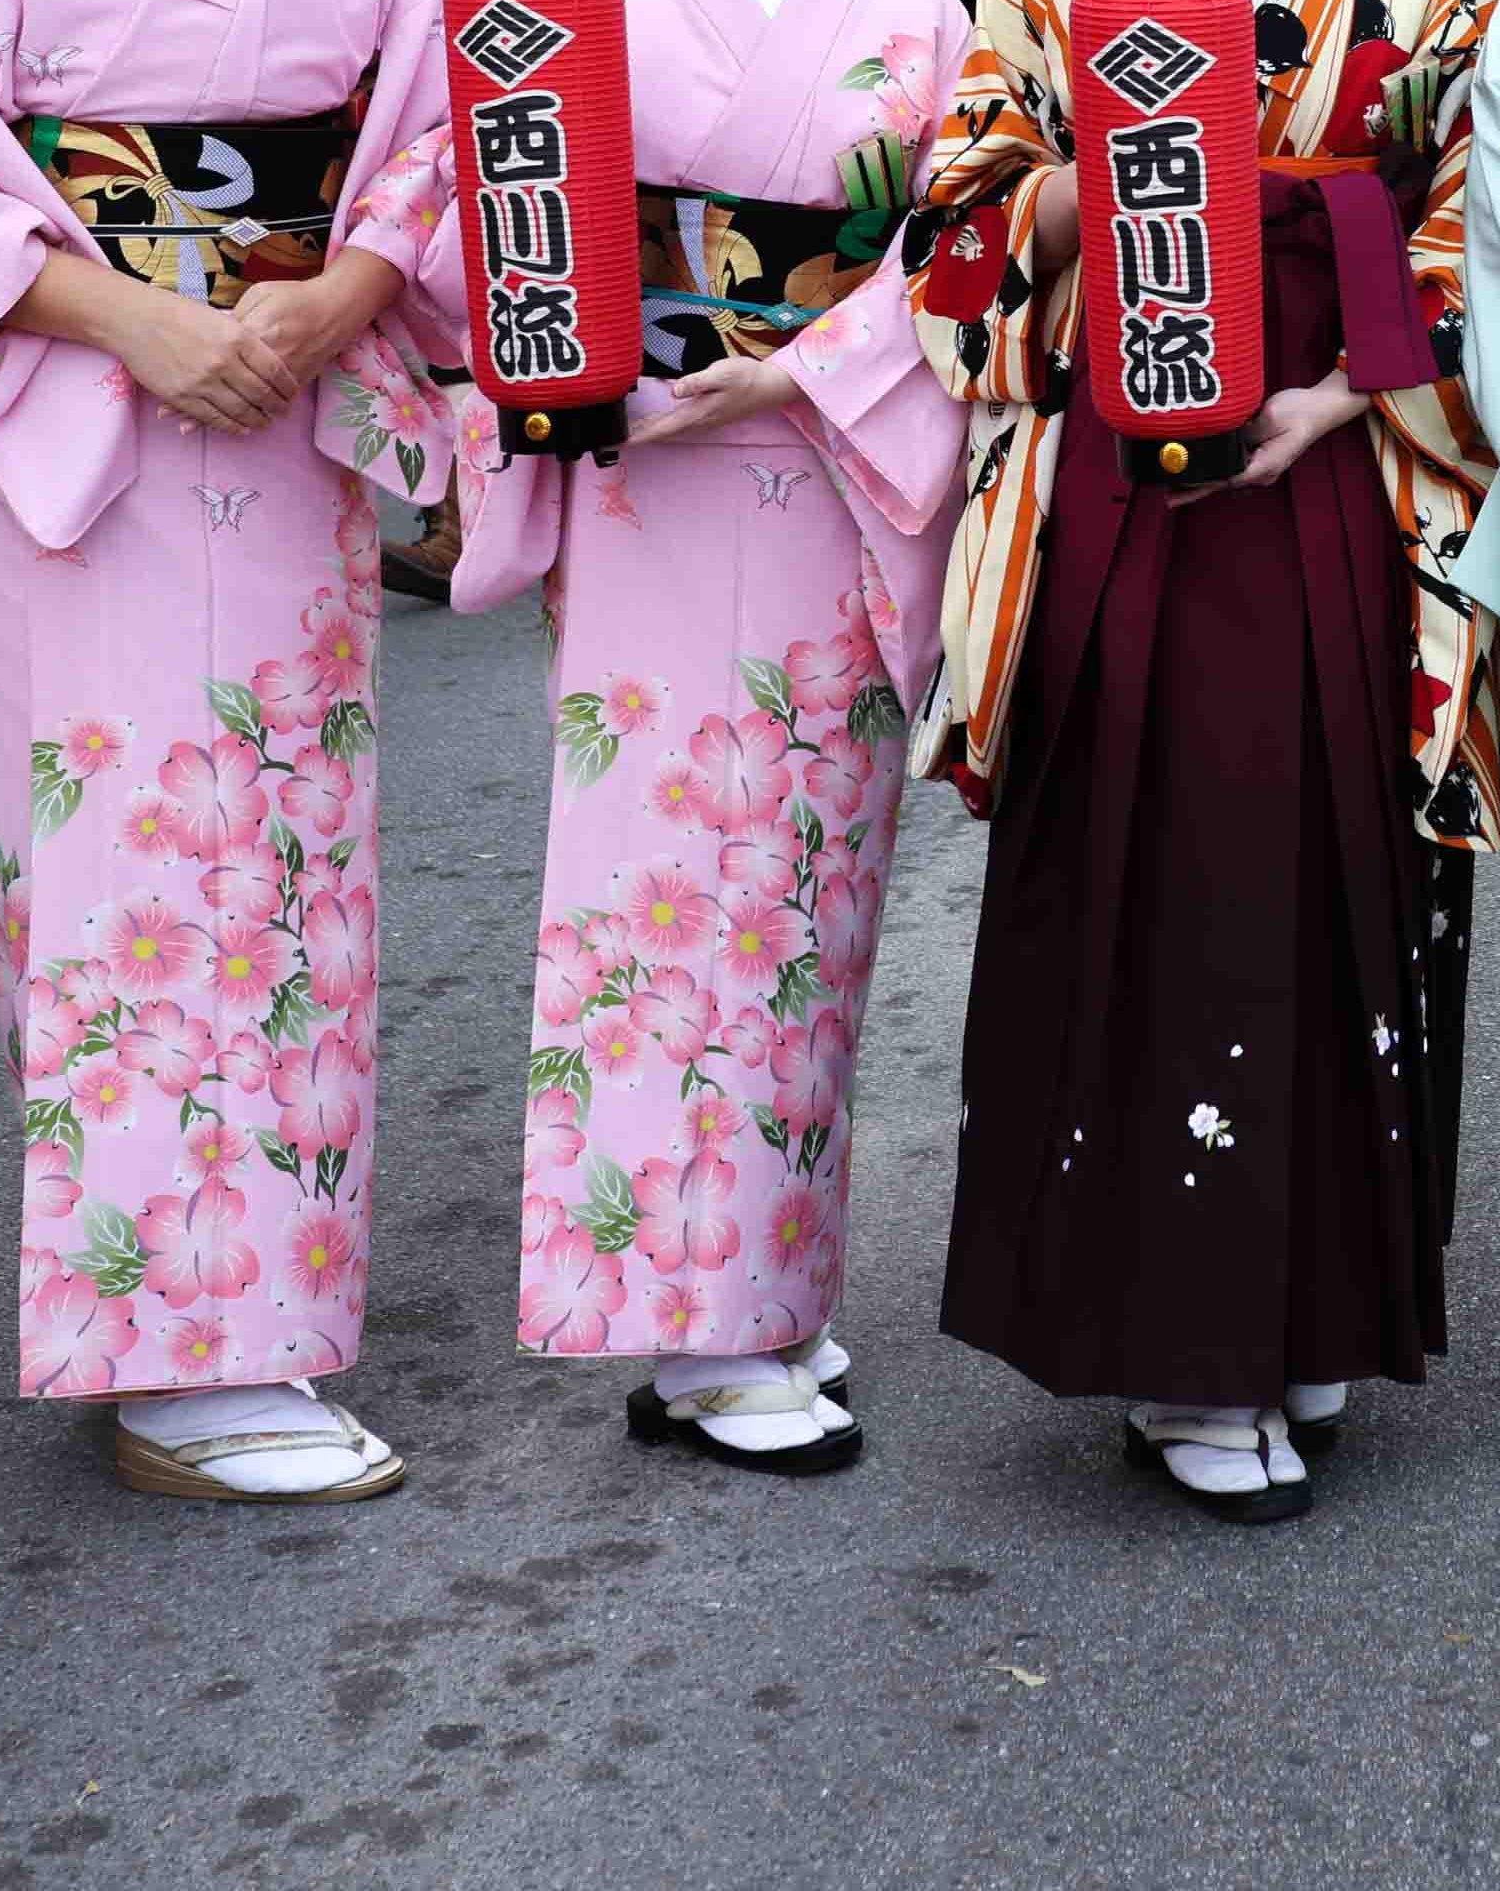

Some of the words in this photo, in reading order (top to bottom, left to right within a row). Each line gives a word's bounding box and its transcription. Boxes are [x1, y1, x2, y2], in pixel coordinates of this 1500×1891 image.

[469, 90, 587, 383] 西川流
[1107, 115, 1222, 414] 西川流
